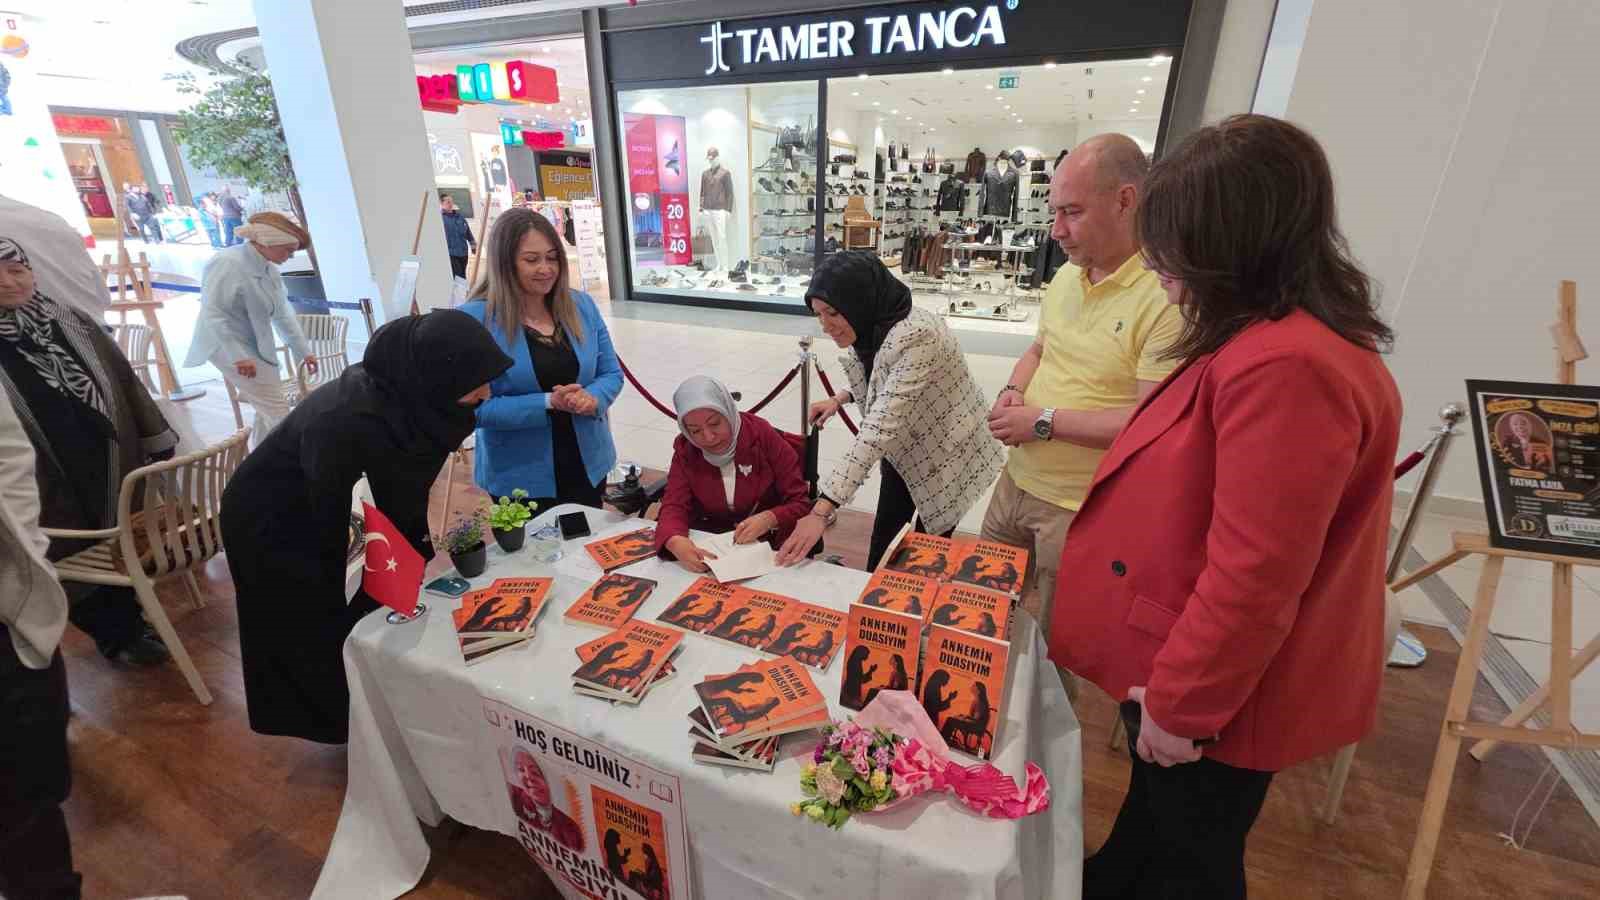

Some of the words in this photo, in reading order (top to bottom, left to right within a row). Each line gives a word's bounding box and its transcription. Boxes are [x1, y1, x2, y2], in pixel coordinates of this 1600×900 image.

[736, 20, 855, 64] TAMER
[865, 6, 1006, 54] TANCA
[667, 204, 684, 219] 20
[670, 239, 687, 254] 40
[858, 628, 907, 650] DUASIYIM
[859, 616, 909, 637] ANNEMİN
[938, 651, 991, 677] DUASIYIM
[940, 639, 993, 665] ANNEMİN
[514, 719, 548, 754] HOŞ
[552, 737, 632, 789] GELDİNİZ
[604, 799, 649, 826] ANNEMİN
[518, 820, 617, 888] ANNEMİN
[520, 834, 629, 900] DUASIYI
